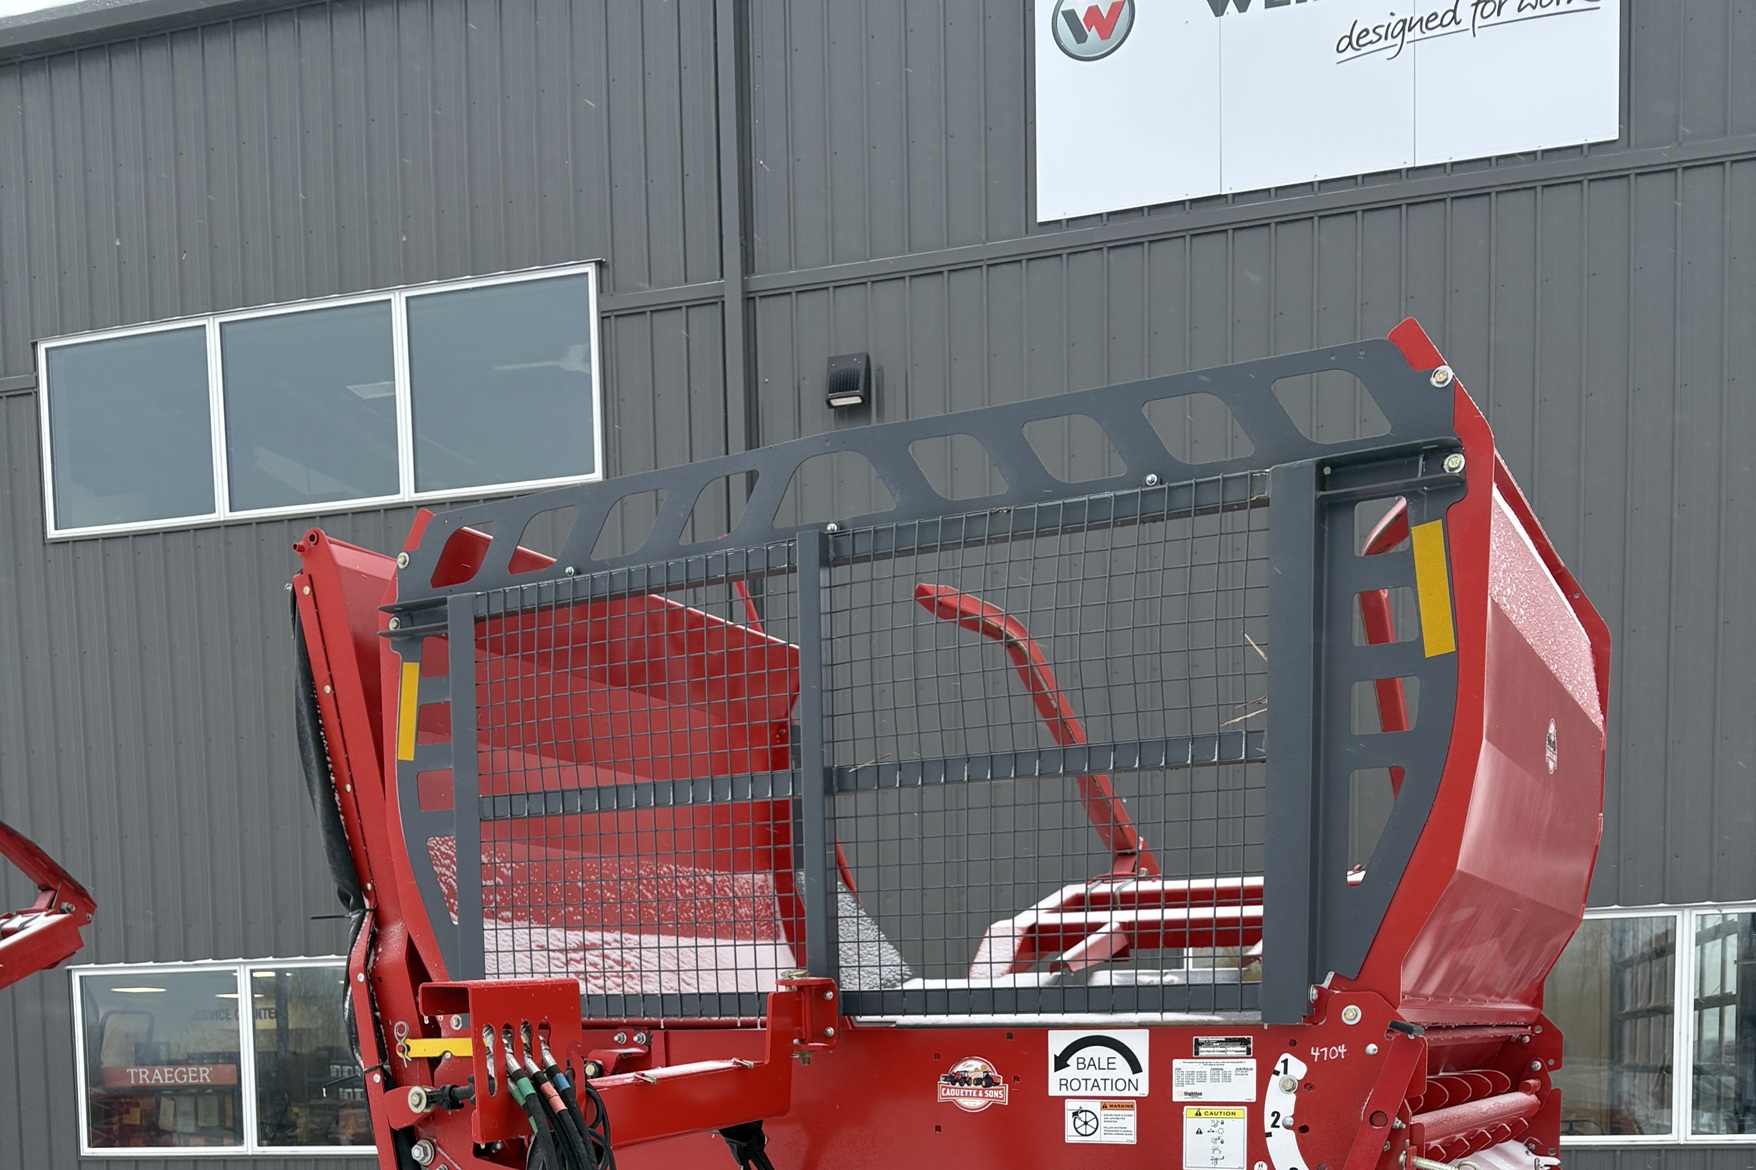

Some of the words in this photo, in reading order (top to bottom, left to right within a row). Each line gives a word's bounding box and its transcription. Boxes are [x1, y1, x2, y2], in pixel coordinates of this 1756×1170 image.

[1336, 0, 1462, 60] designed
[1311, 1044, 1347, 1063] 4704
[1076, 1056, 1117, 1071] BALE
[1281, 1058, 1289, 1075] 1
[127, 1067, 212, 1085] TRAEGER
[1059, 1077, 1139, 1092] ROTATION
[984, 1089, 1003, 1098] SONS
[1270, 1111, 1281, 1128] 2
